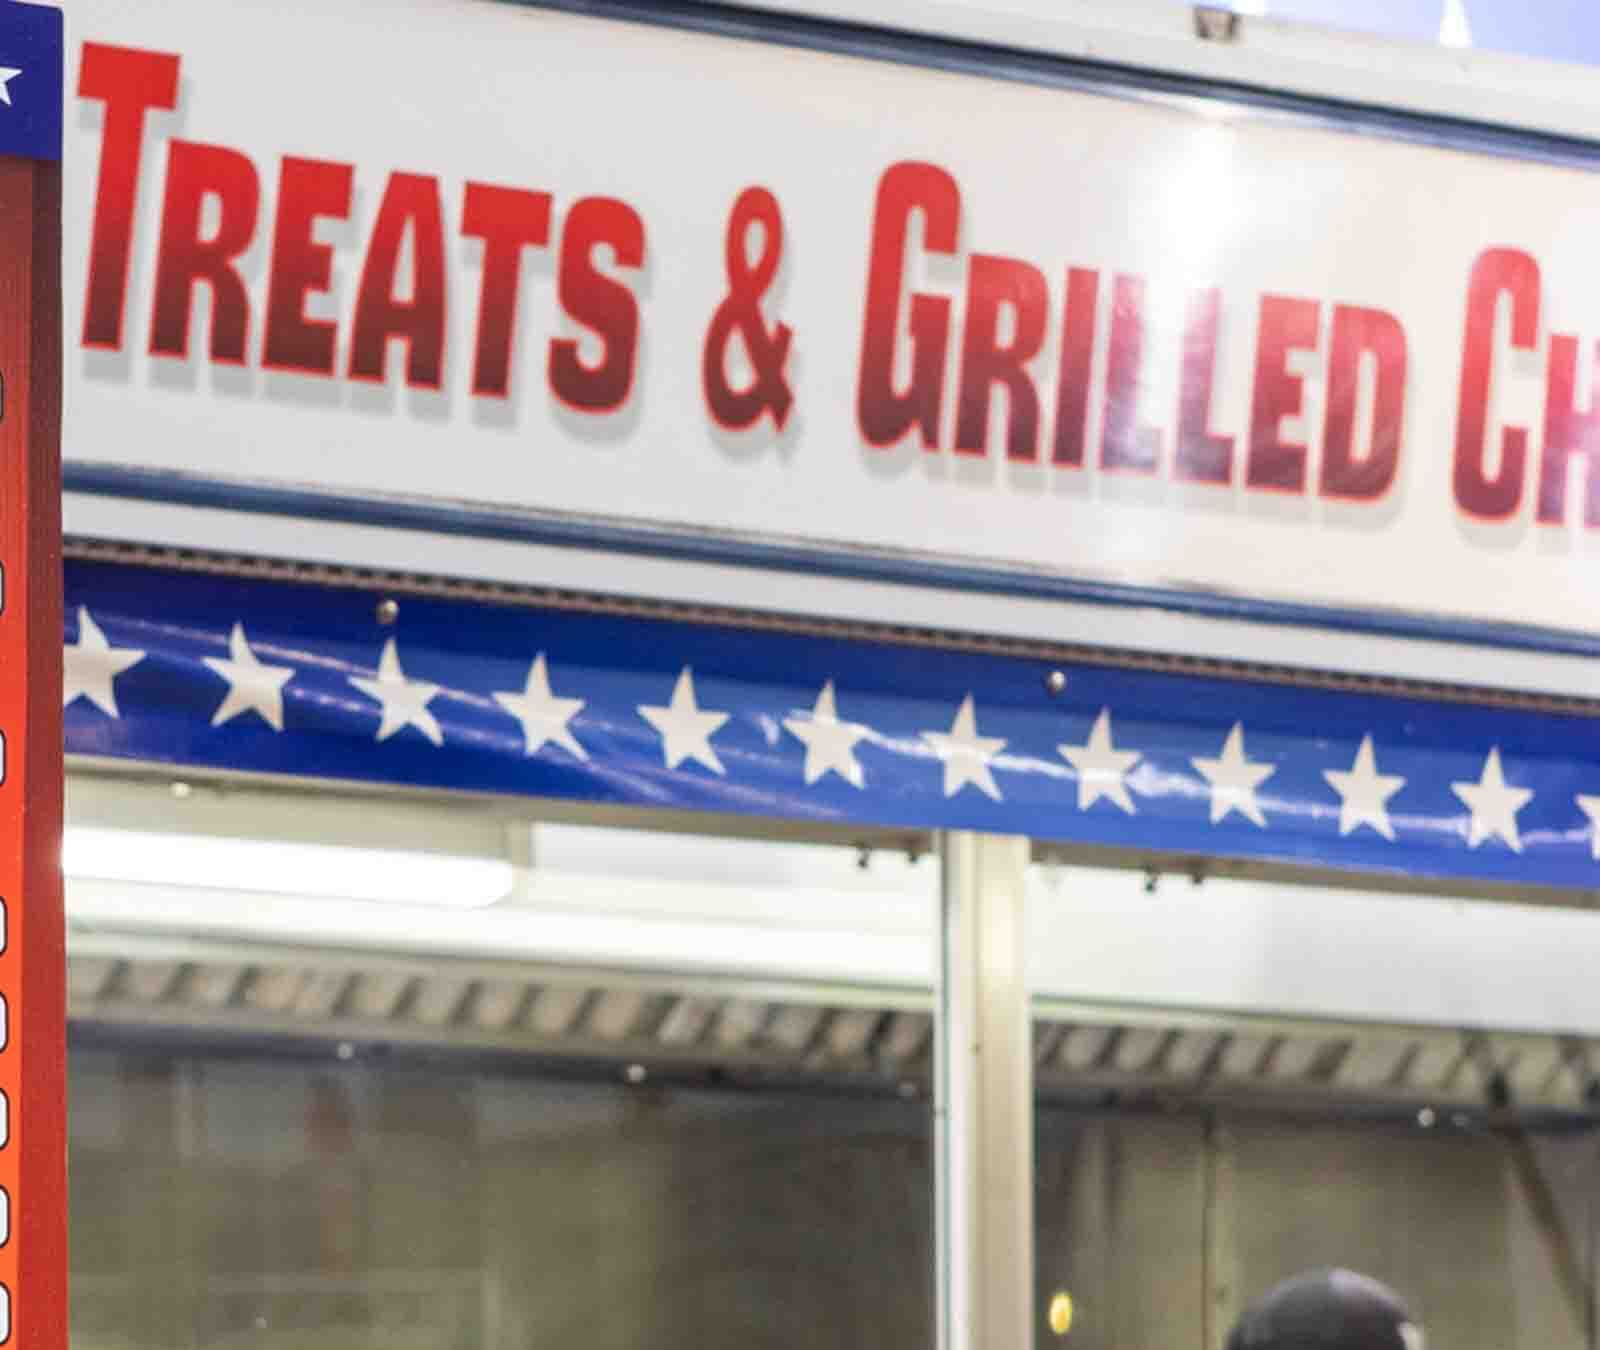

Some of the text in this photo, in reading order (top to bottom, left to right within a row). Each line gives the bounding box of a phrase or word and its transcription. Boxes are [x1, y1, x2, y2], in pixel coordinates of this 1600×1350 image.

[76, 40, 648, 415] TREATS
[702, 184, 794, 434] &
[856, 160, 1406, 503] GRILLED
